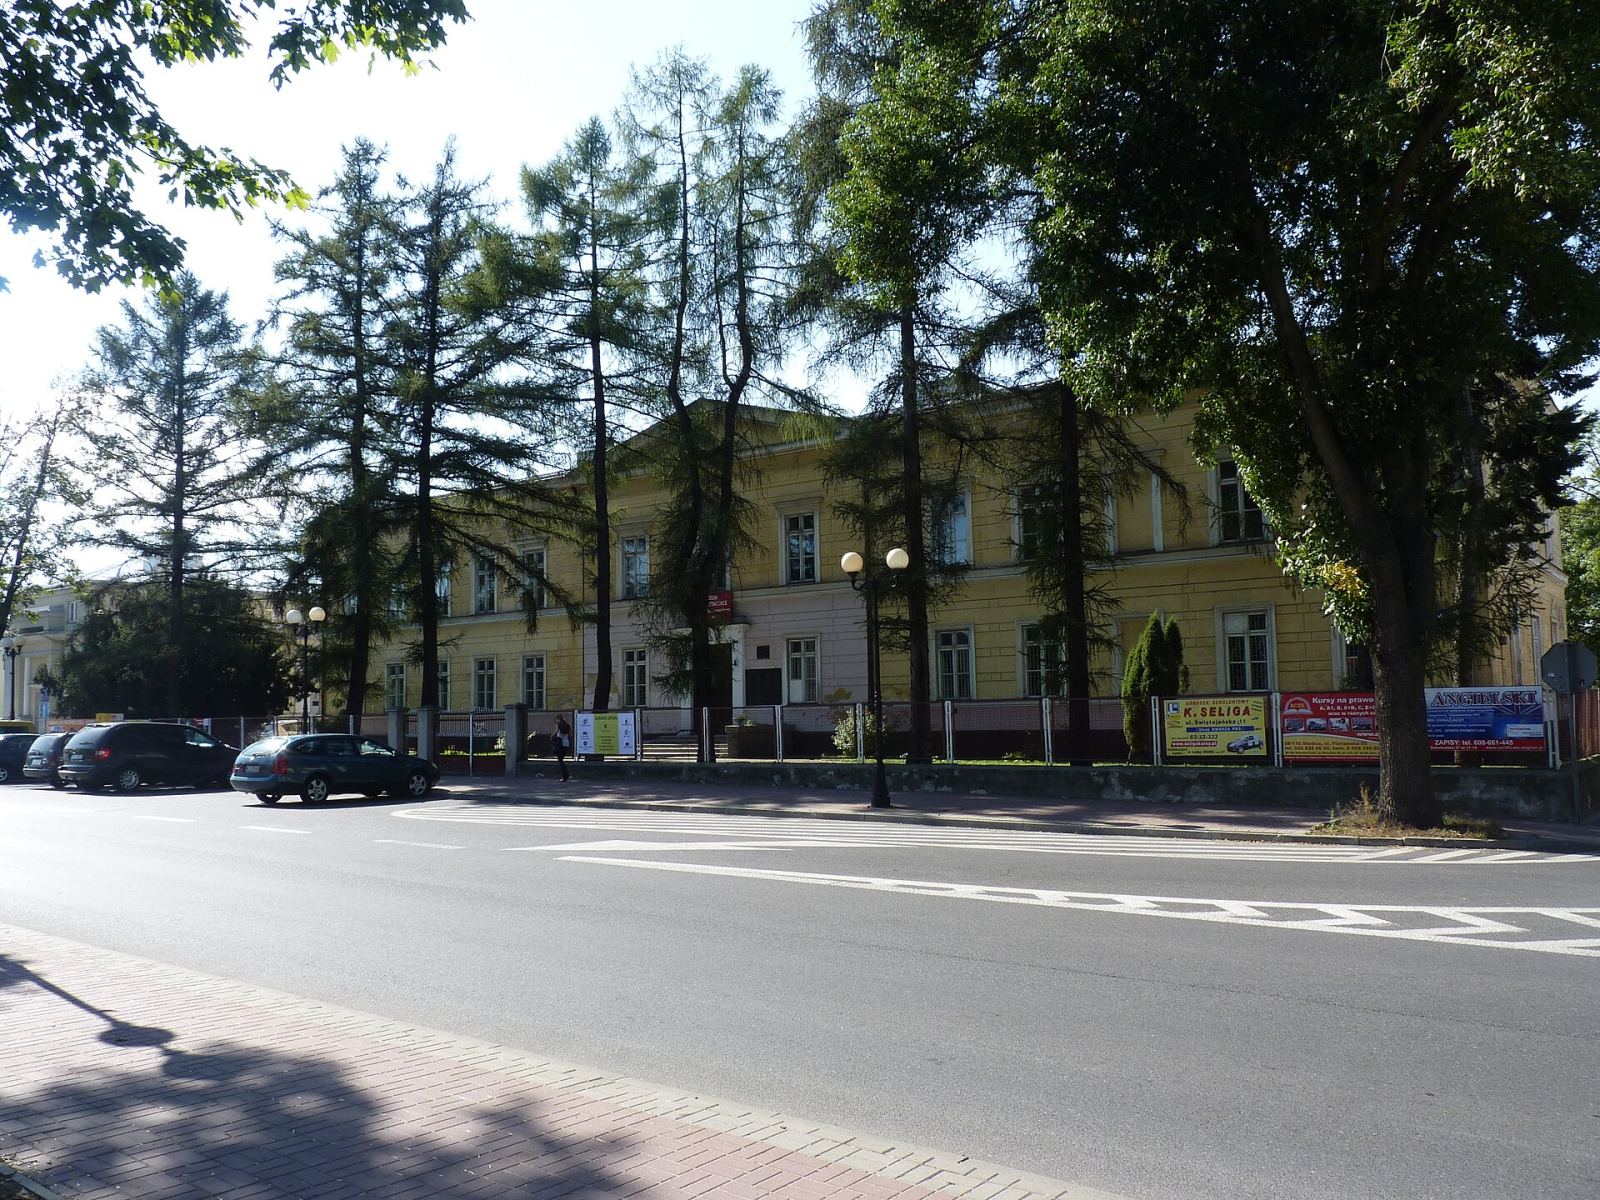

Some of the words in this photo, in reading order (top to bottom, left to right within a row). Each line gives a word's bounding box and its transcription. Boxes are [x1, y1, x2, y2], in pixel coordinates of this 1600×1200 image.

[1312, 697, 1335, 705] Kursy
[1349, 697, 1375, 705] prawo
[1432, 691, 1537, 706] ANGIELSKI
[1184, 706, 1197, 718] K.
[1199, 705, 1251, 718] SELIGA
